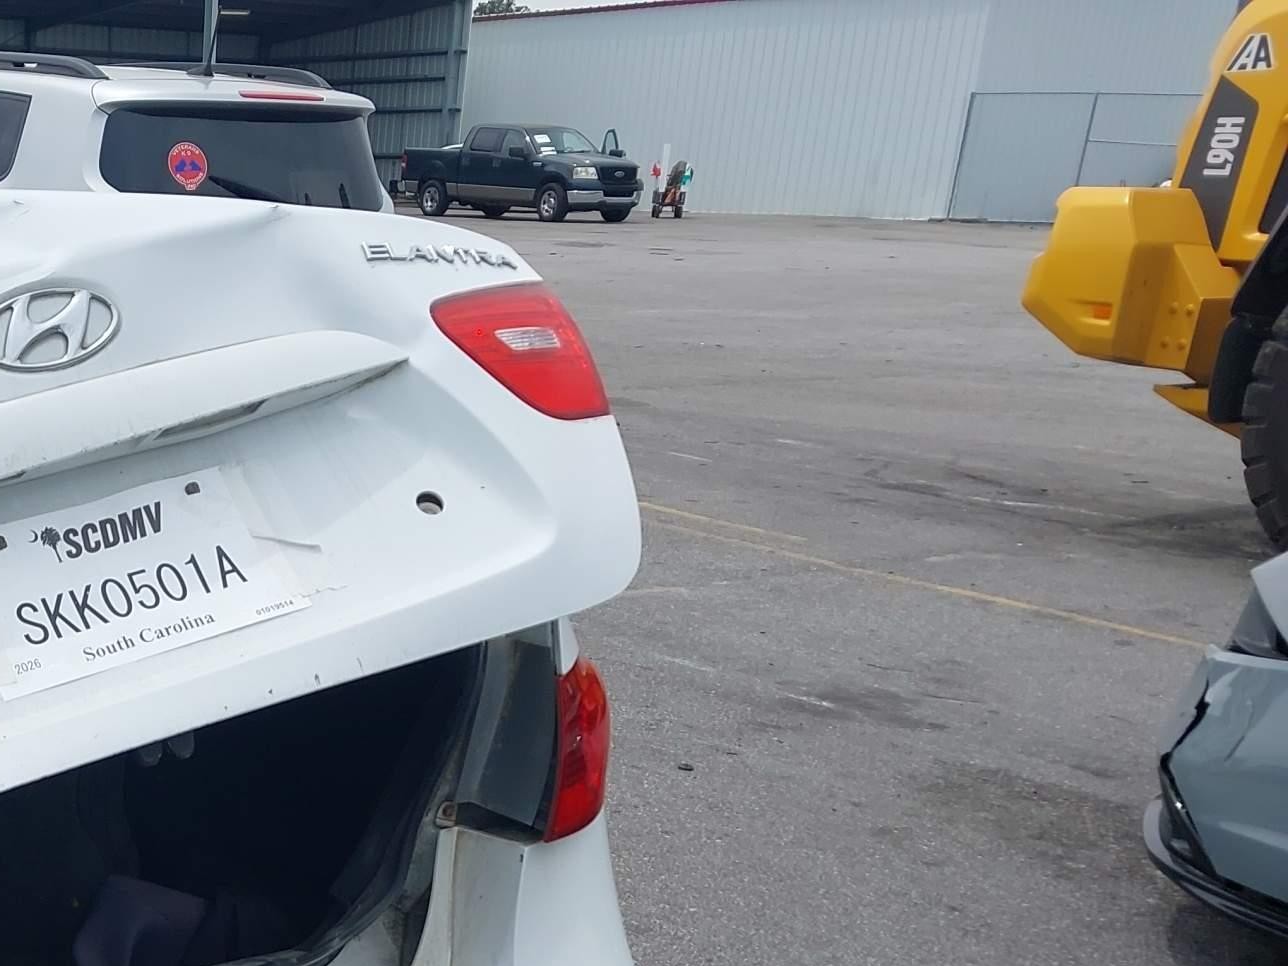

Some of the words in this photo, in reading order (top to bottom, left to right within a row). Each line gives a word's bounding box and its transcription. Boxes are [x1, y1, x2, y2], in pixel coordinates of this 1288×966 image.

[1202, 116, 1246, 176] L90H
[361, 241, 518, 270] ELANTRA
[62, 501, 162, 559] SCDMV
[16, 545, 248, 645] SKK0501A
[82, 634, 136, 662] South
[139, 612, 215, 644] Carolina
[14, 659, 42, 675] 2026
